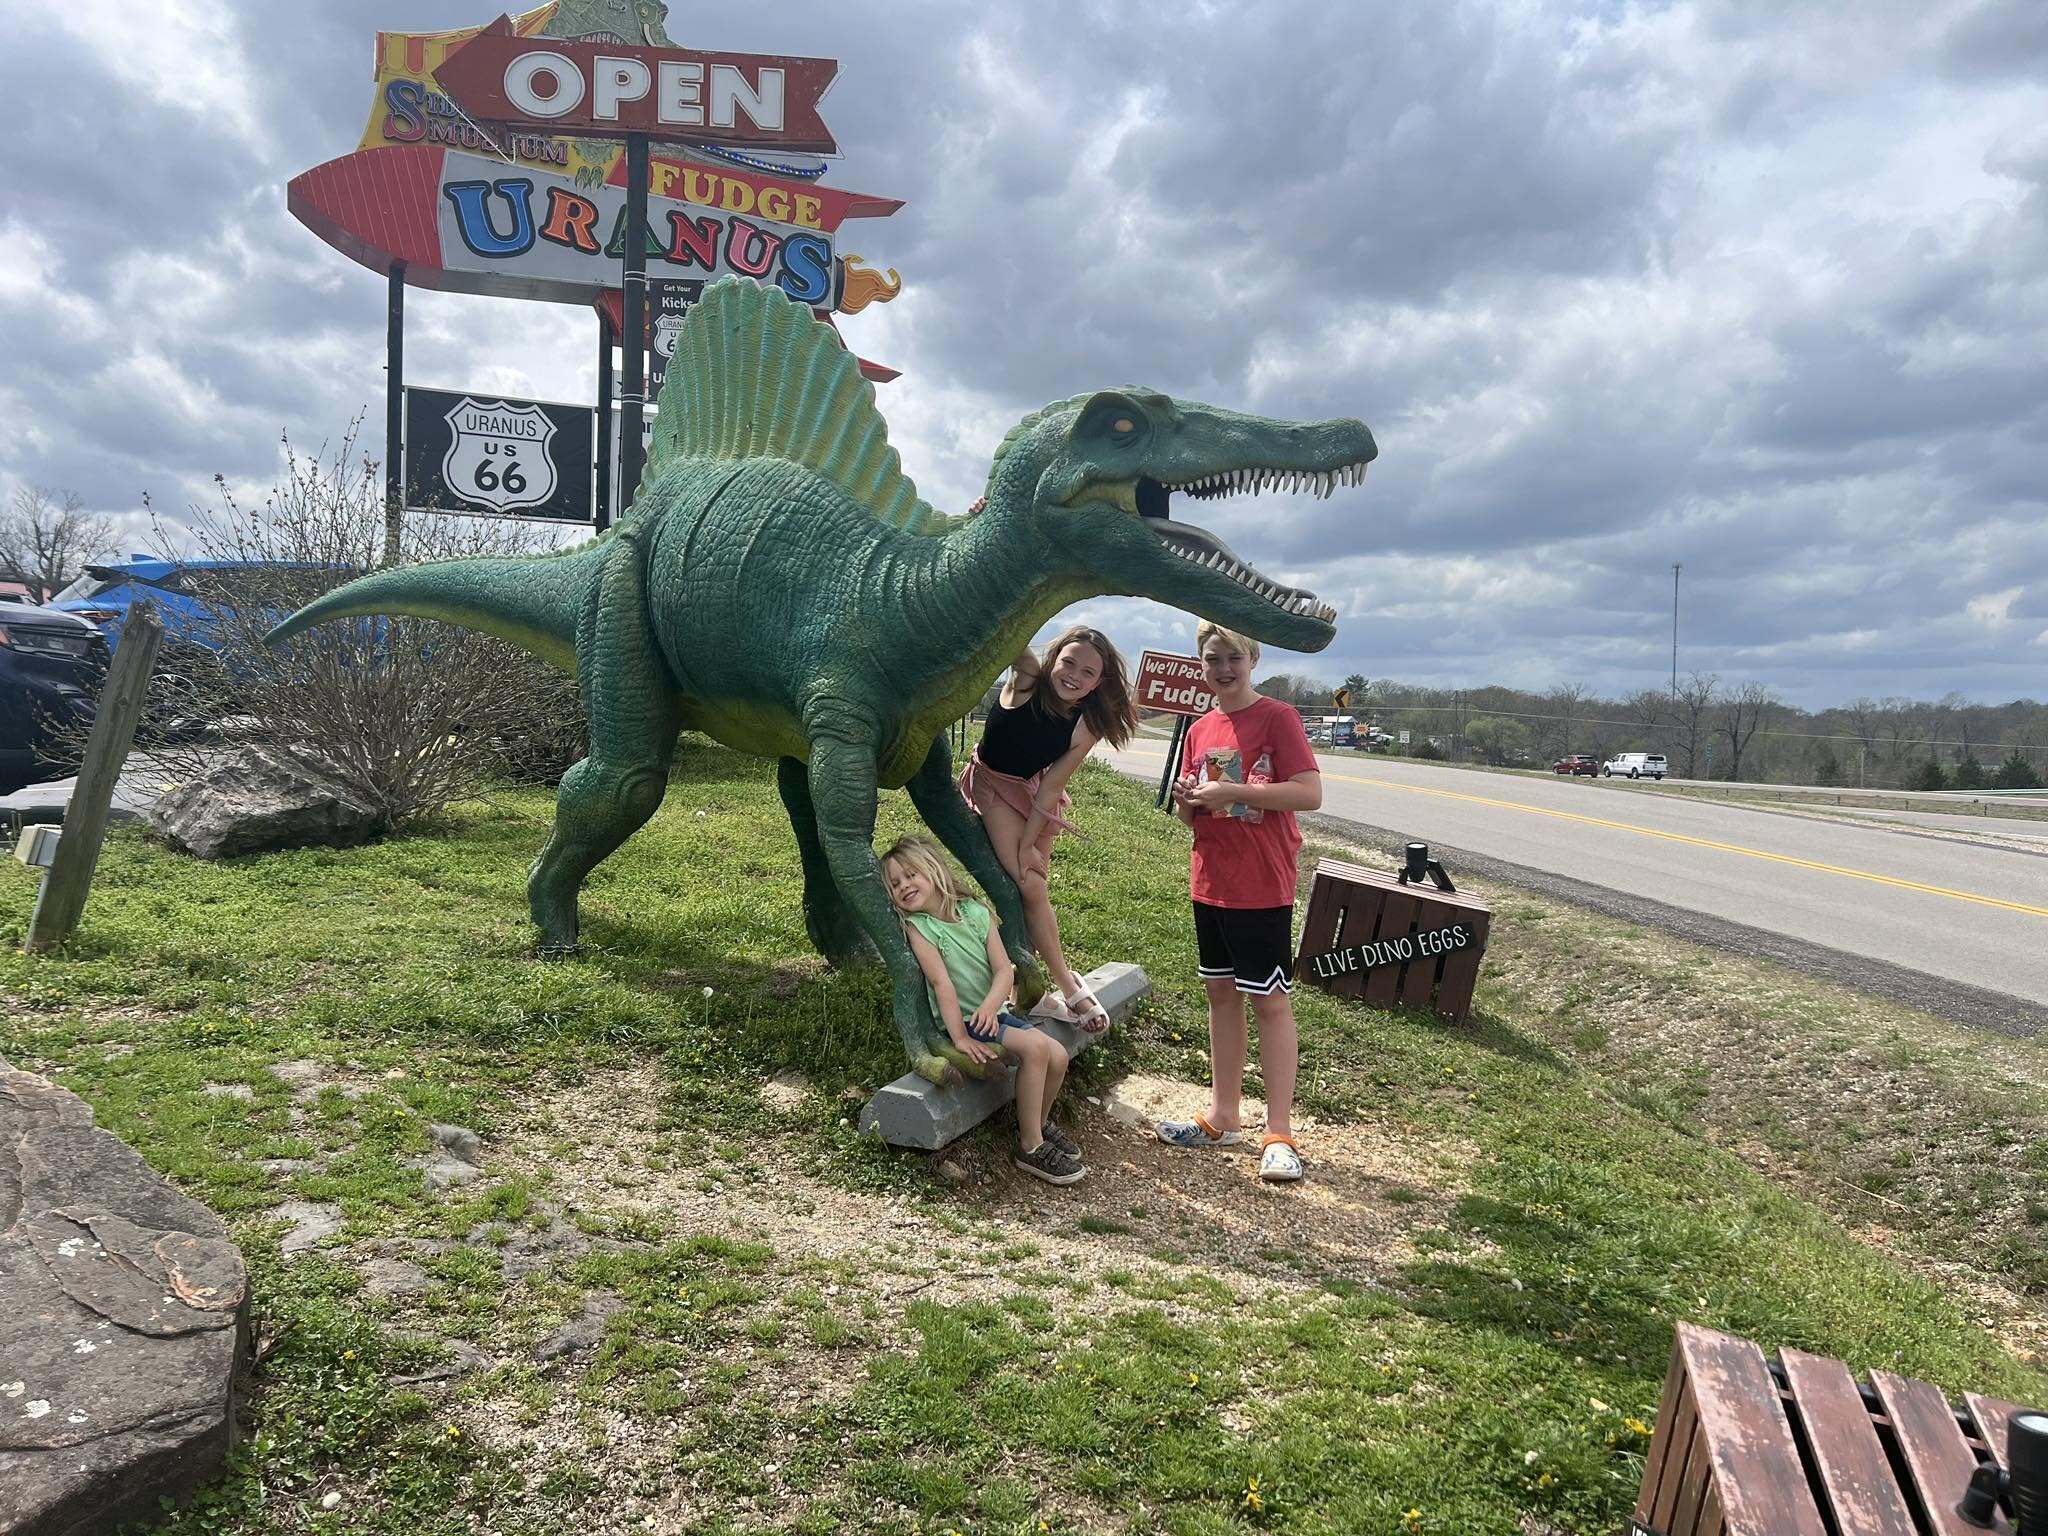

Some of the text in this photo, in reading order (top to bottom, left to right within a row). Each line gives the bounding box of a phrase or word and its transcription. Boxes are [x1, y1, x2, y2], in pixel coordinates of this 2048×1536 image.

[503, 50, 786, 132] OPEN
[650, 161, 822, 230] FUDGE
[445, 179, 831, 304] URANUS
[663, 284, 692, 293] Get Your
[466, 413, 537, 437] URANUS
[484, 442, 517, 457] US
[474, 458, 527, 494] 66
[1145, 657, 1179, 677] We'll
[1147, 679, 1220, 713] Fudge
[1315, 925, 1467, 978] LIVE DINO EGGS
